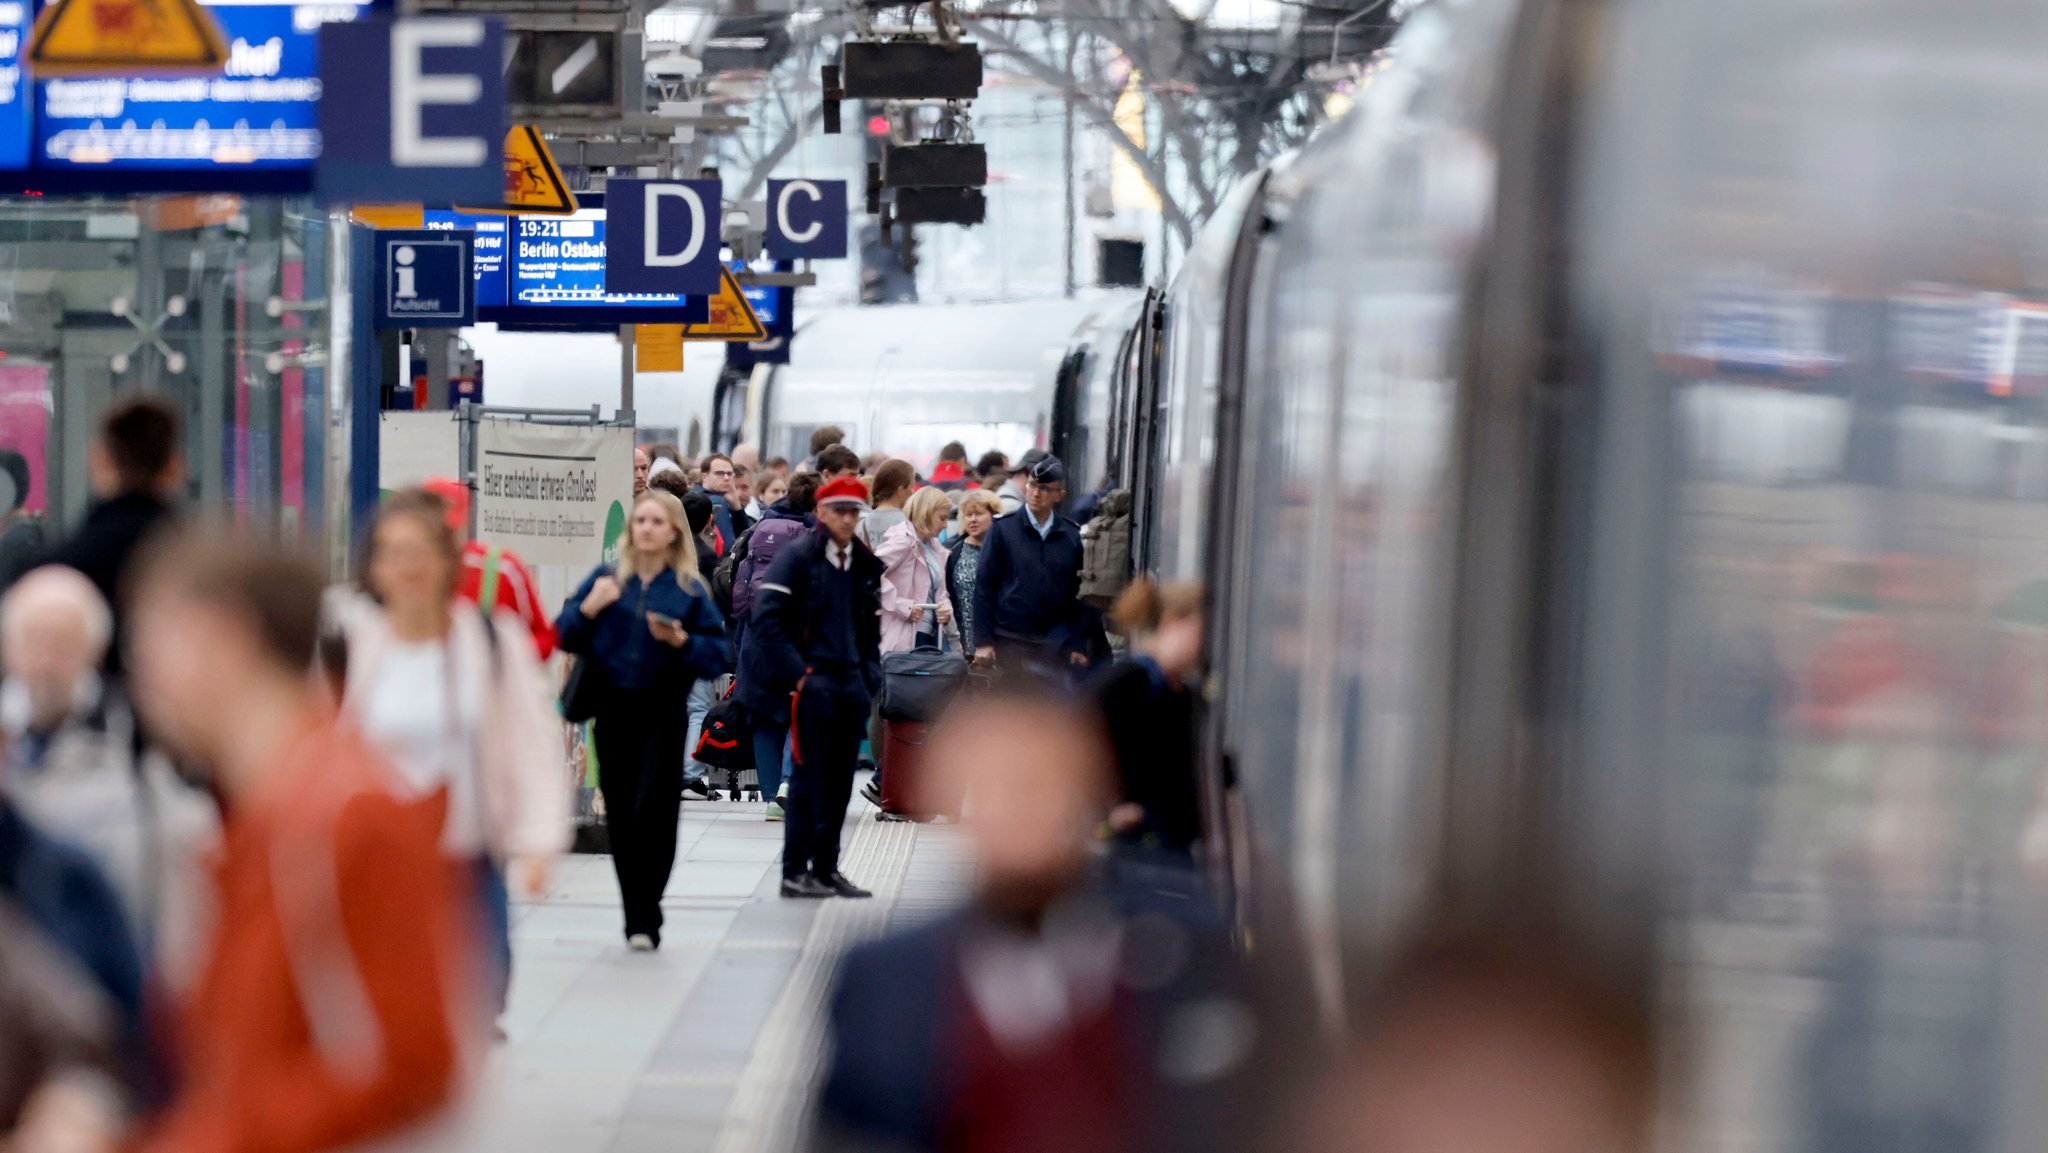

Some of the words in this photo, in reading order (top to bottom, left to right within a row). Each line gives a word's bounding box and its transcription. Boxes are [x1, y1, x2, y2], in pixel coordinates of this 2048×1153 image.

[390, 16, 488, 168] E
[644, 183, 706, 267] D
[776, 180, 823, 243] C
[474, 237, 485, 249] tf)
[485, 237, 502, 248] Hbf
[519, 221, 560, 237] 19:21
[519, 241, 559, 258] Berlin
[560, 240, 607, 258] Ostbah
[393, 299, 440, 311] Aufsicht
[484, 463, 502, 497] Hier
[504, 467, 539, 500] entsteht
[541, 471, 565, 501] etwas
[566, 469, 597, 502] Großes!
